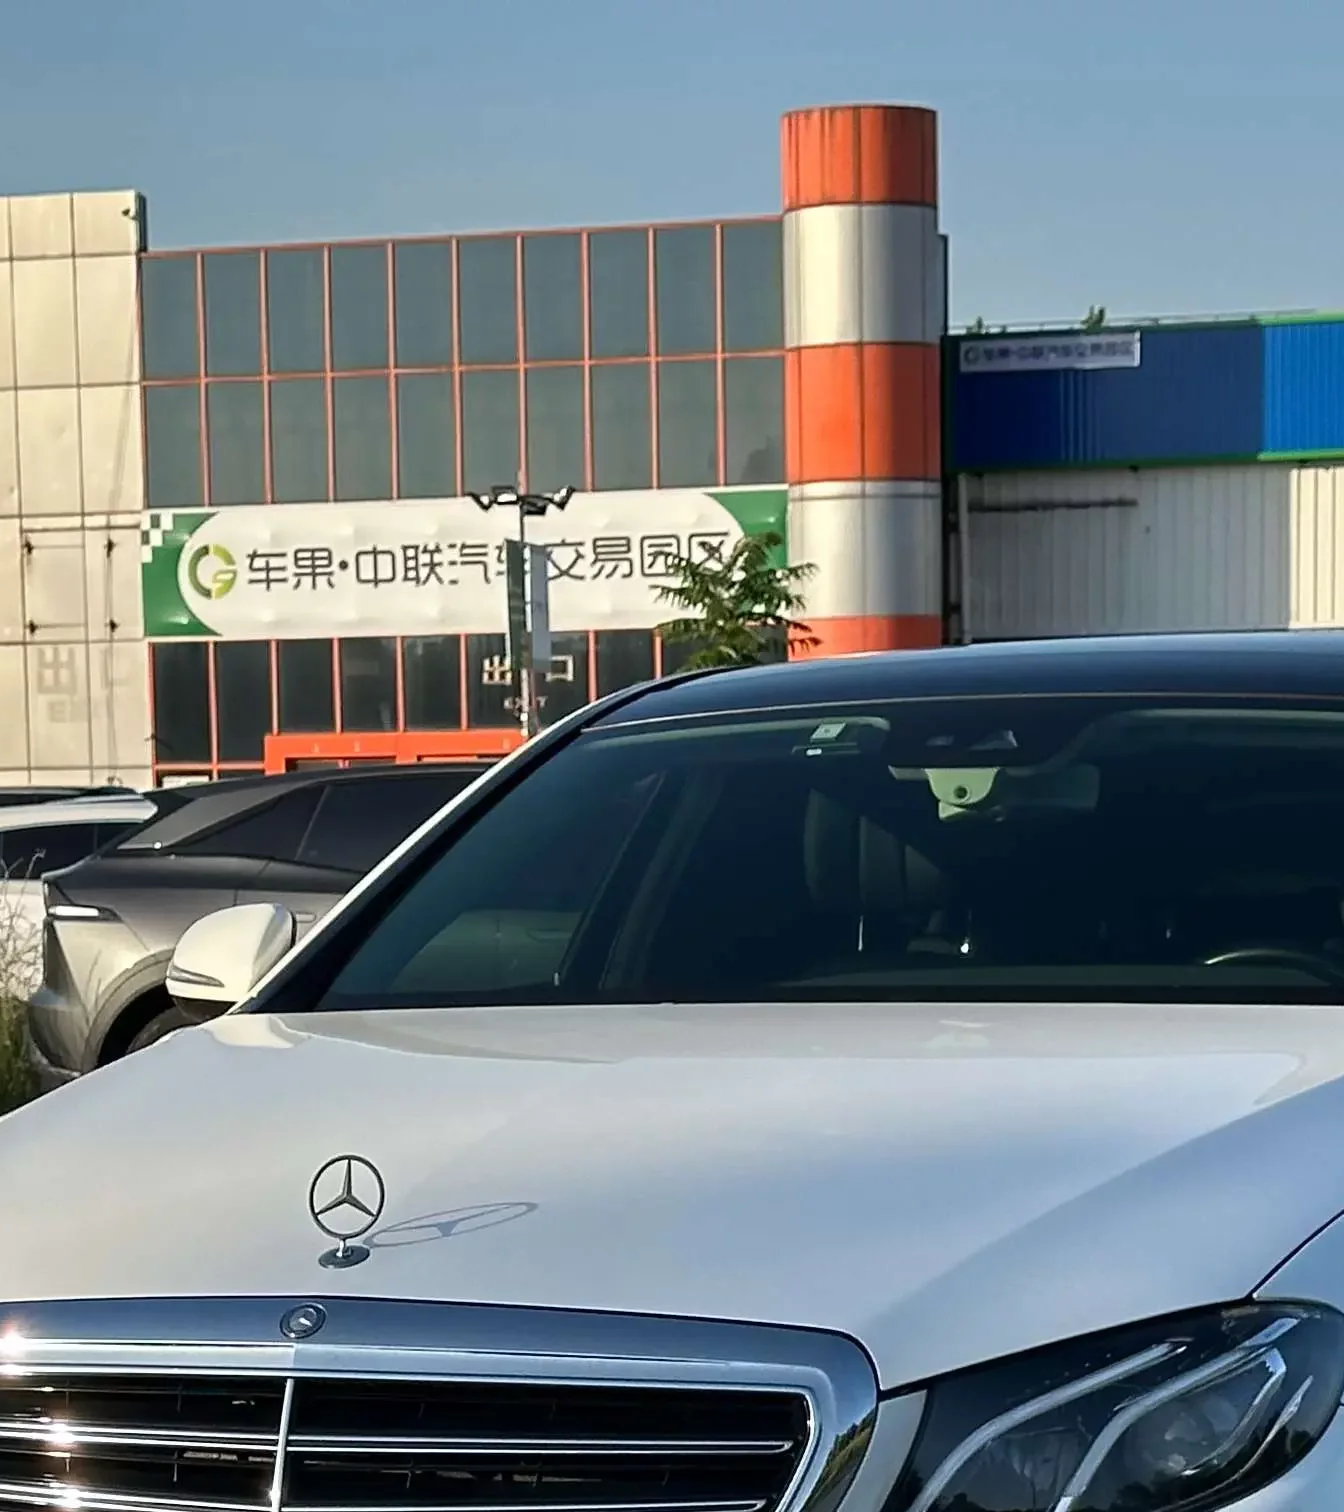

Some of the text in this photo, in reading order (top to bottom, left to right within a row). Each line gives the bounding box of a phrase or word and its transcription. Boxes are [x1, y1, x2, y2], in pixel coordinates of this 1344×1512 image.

[246, 532, 731, 592] 车果·中联汽交易园区
